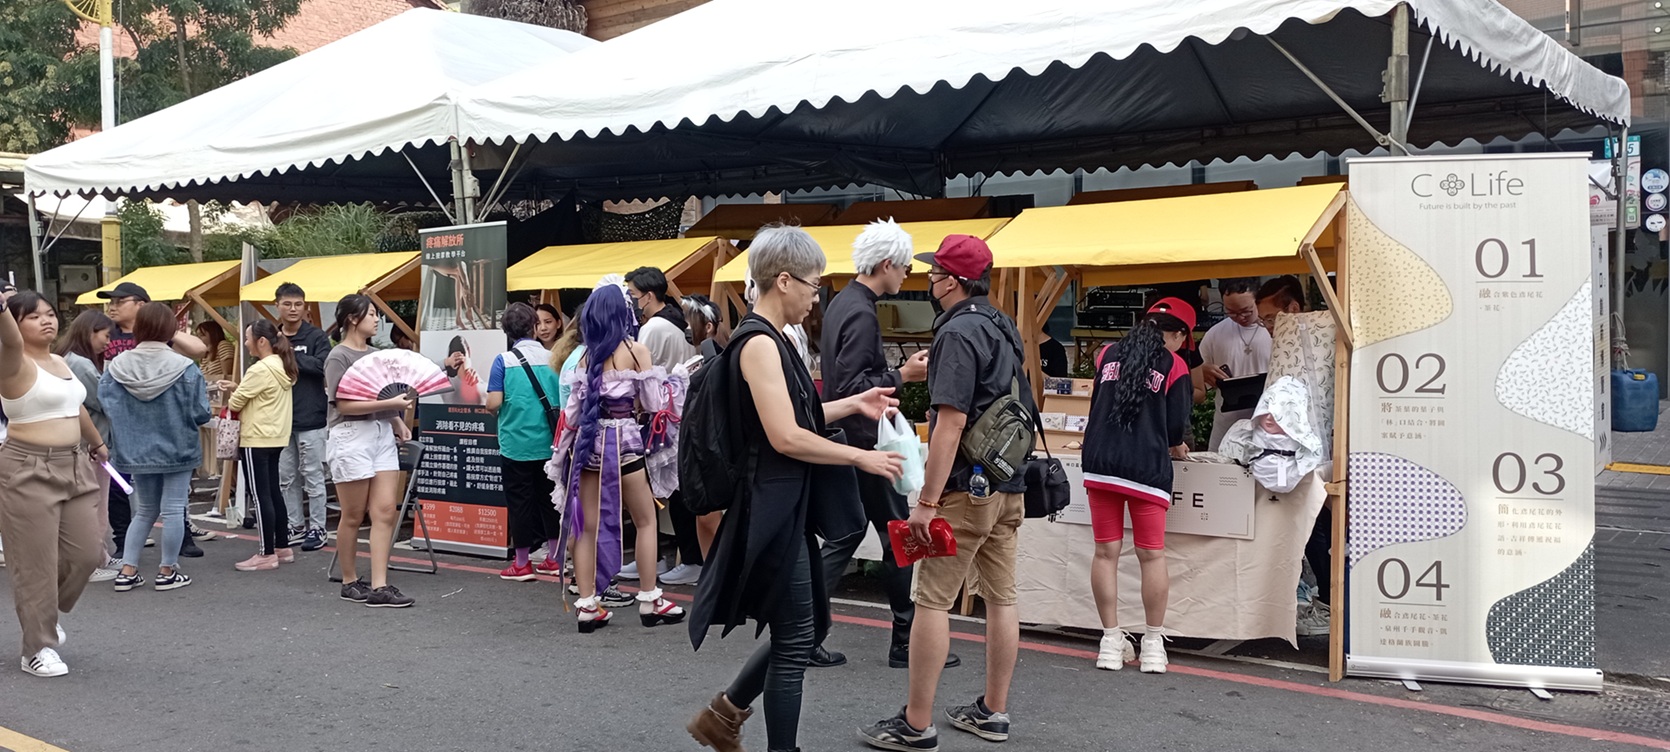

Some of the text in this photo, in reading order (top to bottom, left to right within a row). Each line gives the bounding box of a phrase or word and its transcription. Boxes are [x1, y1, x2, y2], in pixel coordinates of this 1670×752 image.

[1419, 201, 1516, 211] Future is built by the past
[1475, 238, 1544, 278] 01
[1376, 352, 1446, 395] 02
[1492, 451, 1566, 496] 03
[1377, 557, 1450, 602] 04
